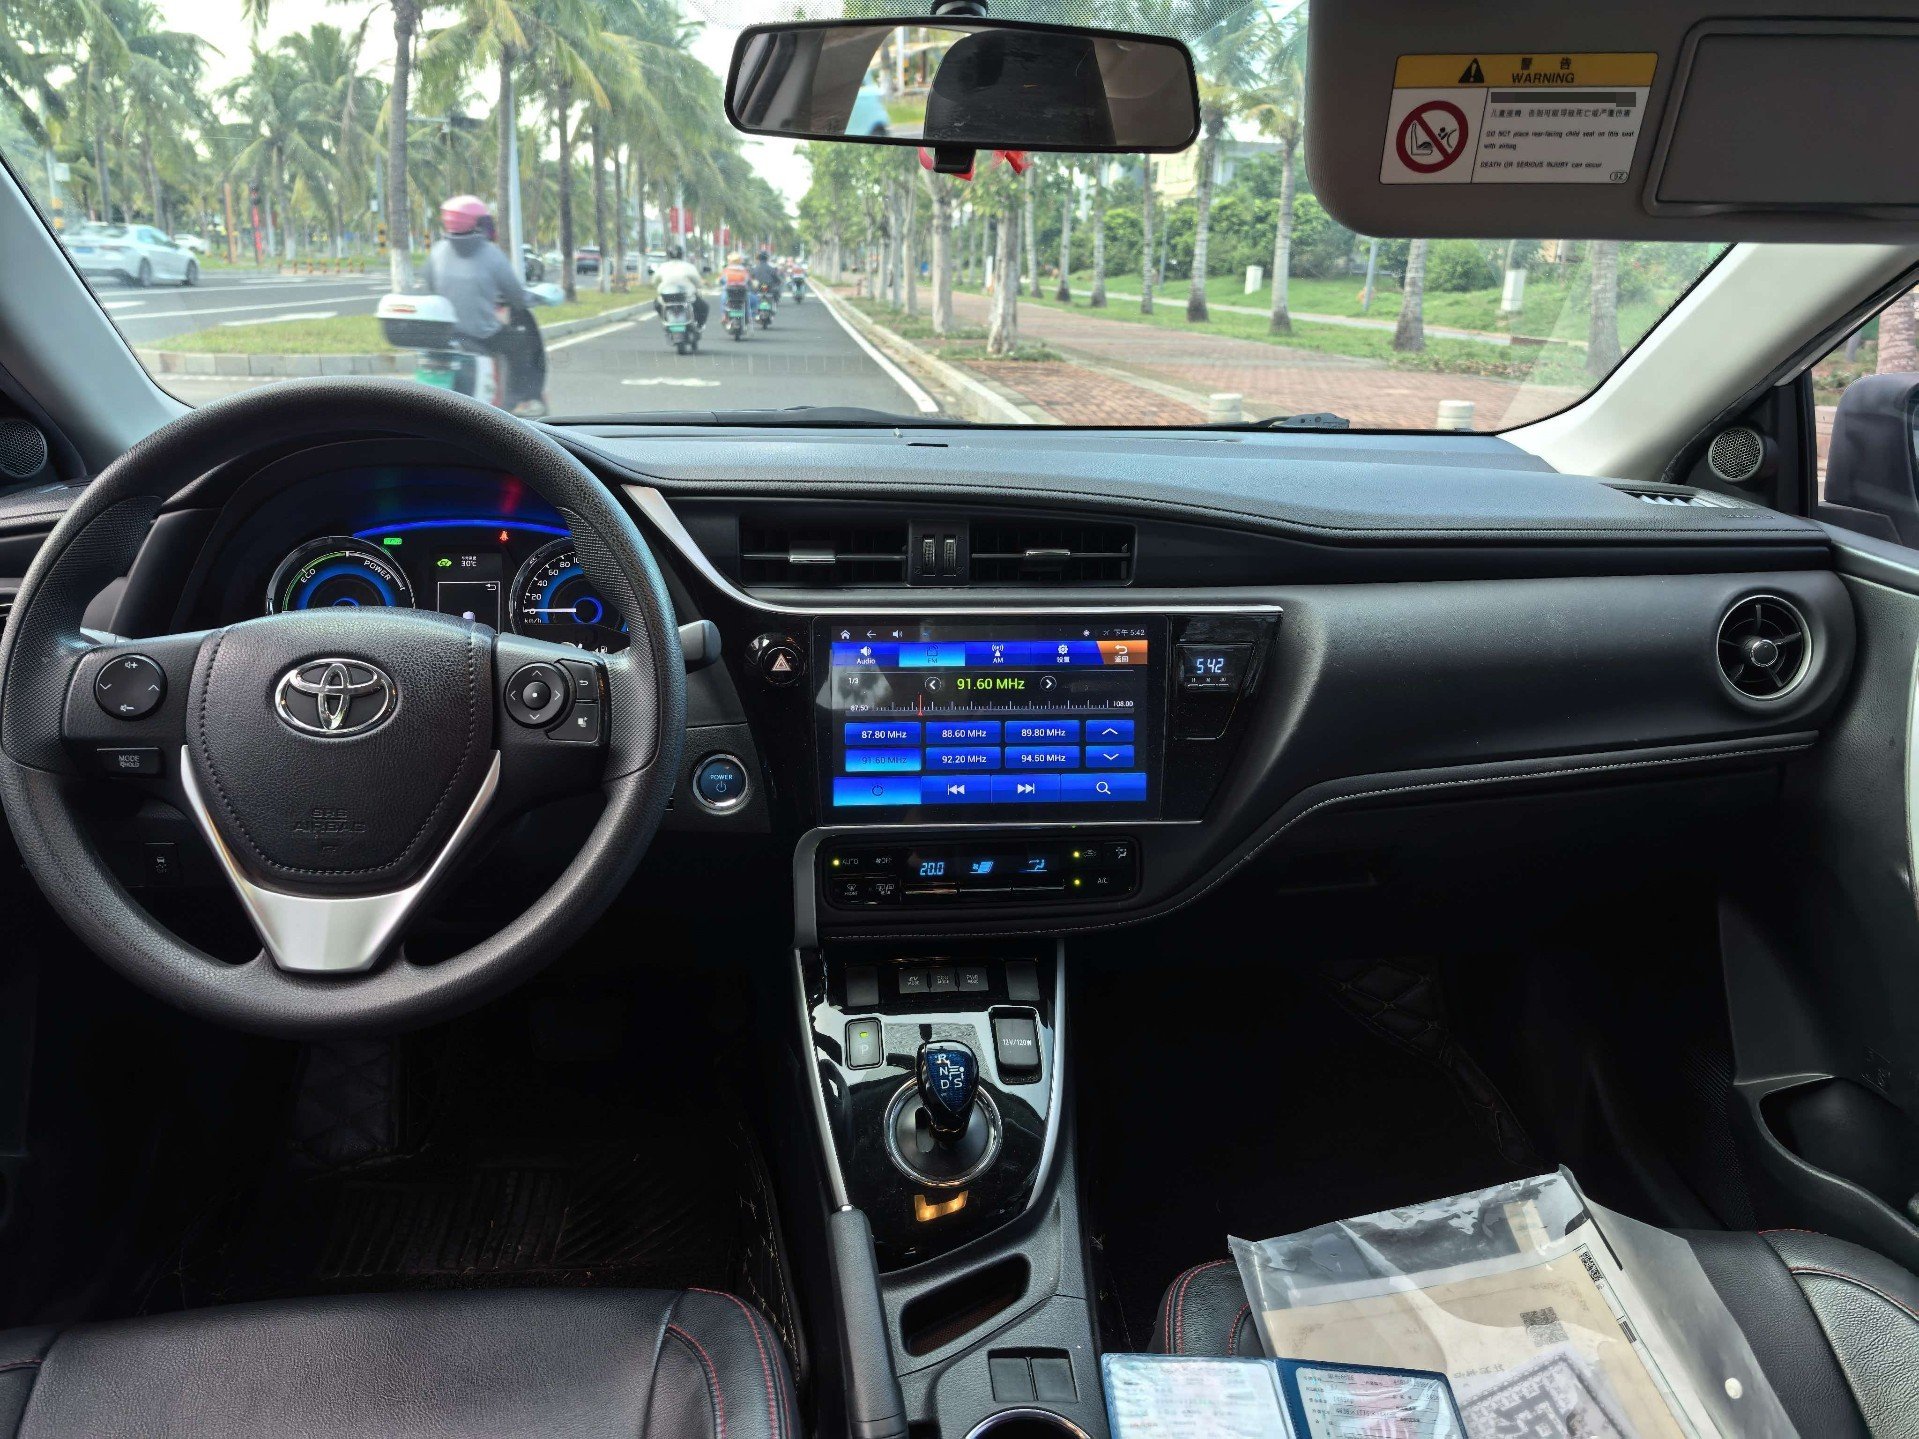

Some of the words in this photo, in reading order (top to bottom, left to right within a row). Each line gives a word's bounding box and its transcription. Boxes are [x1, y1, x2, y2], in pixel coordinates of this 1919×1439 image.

[1512, 72, 1575, 84] WARNING
[1512, 130, 1529, 138] place
[1531, 130, 1563, 138] rear-facing
[1498, 143, 1517, 151] airbag
[363, 560, 391, 581] POWER
[300, 568, 316, 583] ECO
[1130, 628, 1145, 636] 5:42
[856, 657, 876, 665] Audio
[848, 677, 859, 685] 1/3
[956, 678, 993, 690] 91.60
[996, 677, 1026, 690] MHz
[861, 730, 886, 739] 87.80
[887, 730, 908, 739] MHz
[941, 729, 966, 738] 88.60
[967, 729, 988, 738] MHz
[1021, 728, 1045, 737] 89.80
[1046, 728, 1067, 737] MHz
[862, 756, 886, 764] 91.60
[887, 756, 908, 764] MHz
[941, 755, 966, 764] 92.20
[967, 755, 988, 764] MHz
[1046, 754, 1067, 762] MHz
[919, 862, 945, 876] 20.0
[1002, 1038, 1032, 1046] 12V/120W
[861, 1044, 869, 1055] P
[937, 1053, 948, 1064] R
[939, 1066, 949, 1076] N
[940, 1079, 950, 1089] D
[953, 1078, 963, 1088] S
